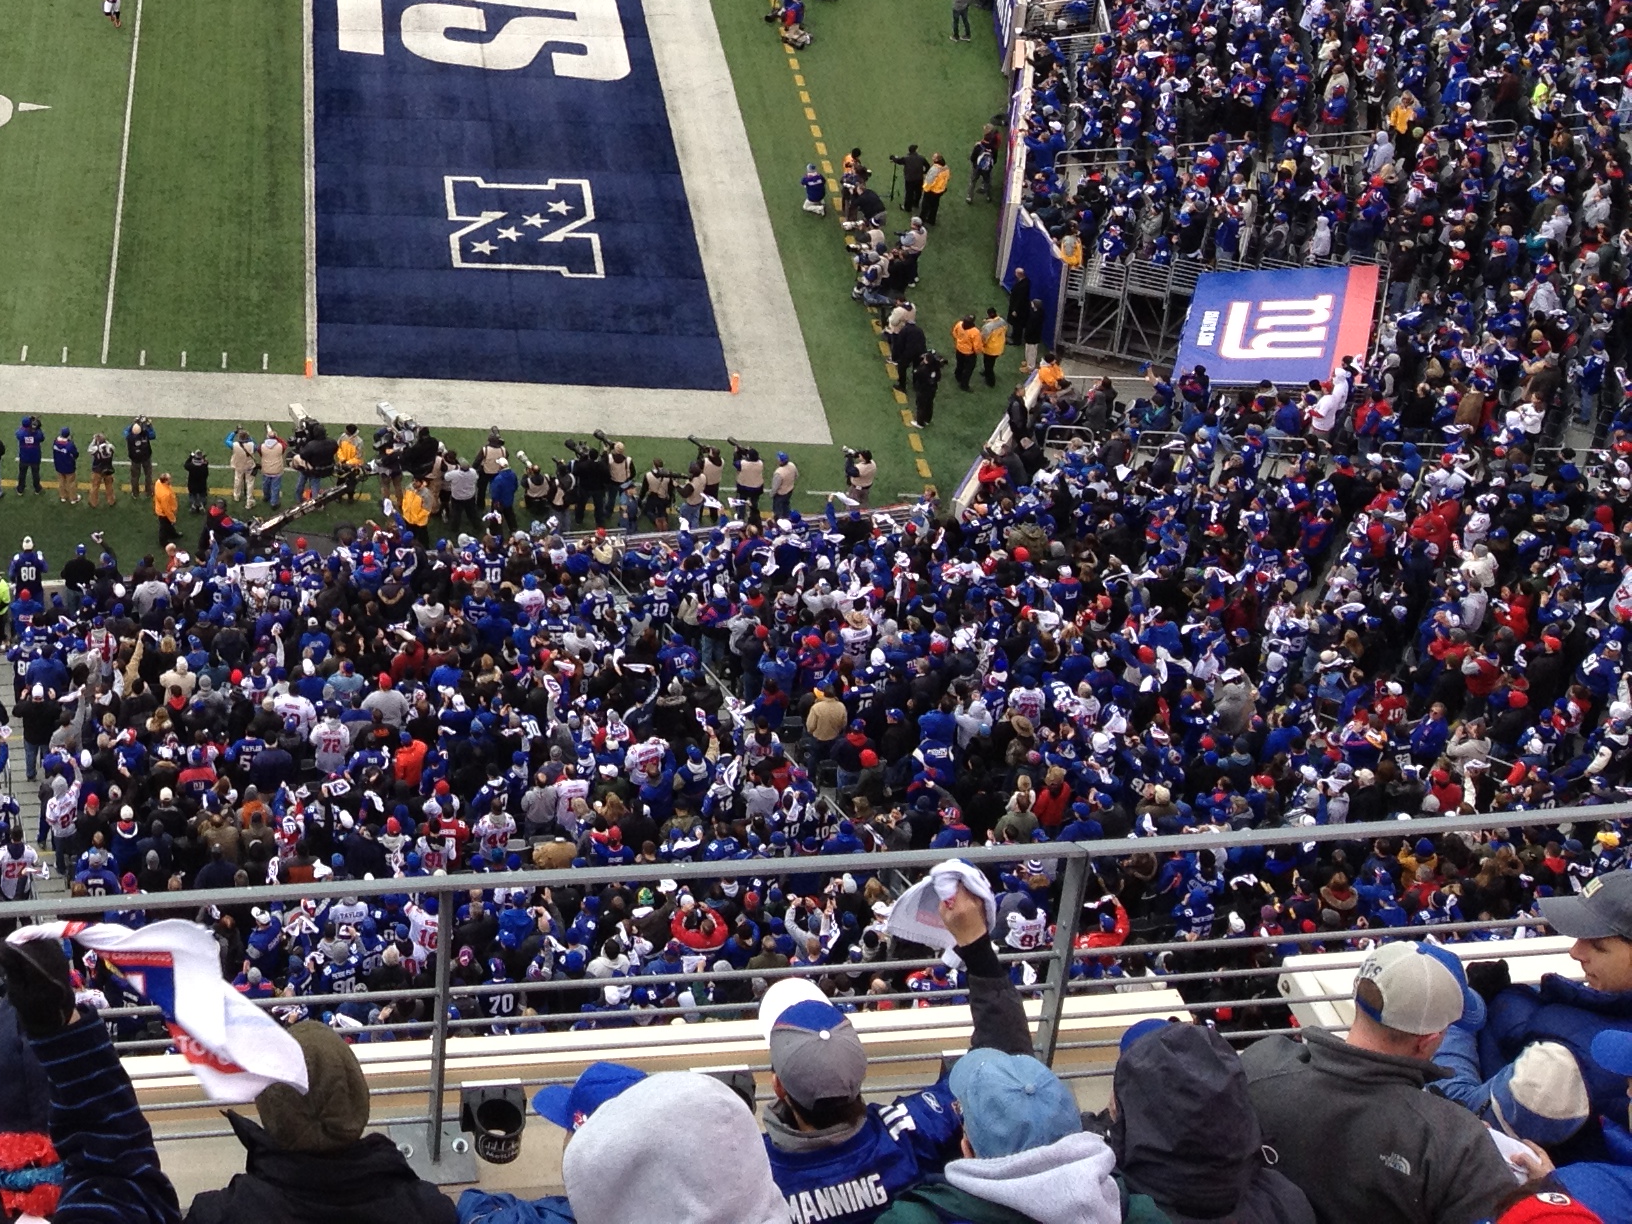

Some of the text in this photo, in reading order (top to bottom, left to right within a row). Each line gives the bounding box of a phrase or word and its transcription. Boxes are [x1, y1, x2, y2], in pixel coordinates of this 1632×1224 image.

[20, 566, 36, 581] 80
[484, 567, 501, 583] 10
[849, 641, 868, 656] 53
[322, 739, 341, 753] 72
[487, 833, 509, 848] 44
[339, 911, 365, 920] TAYLOR
[489, 993, 514, 1014] 70
[786, 1173, 888, 1224] MANNING
